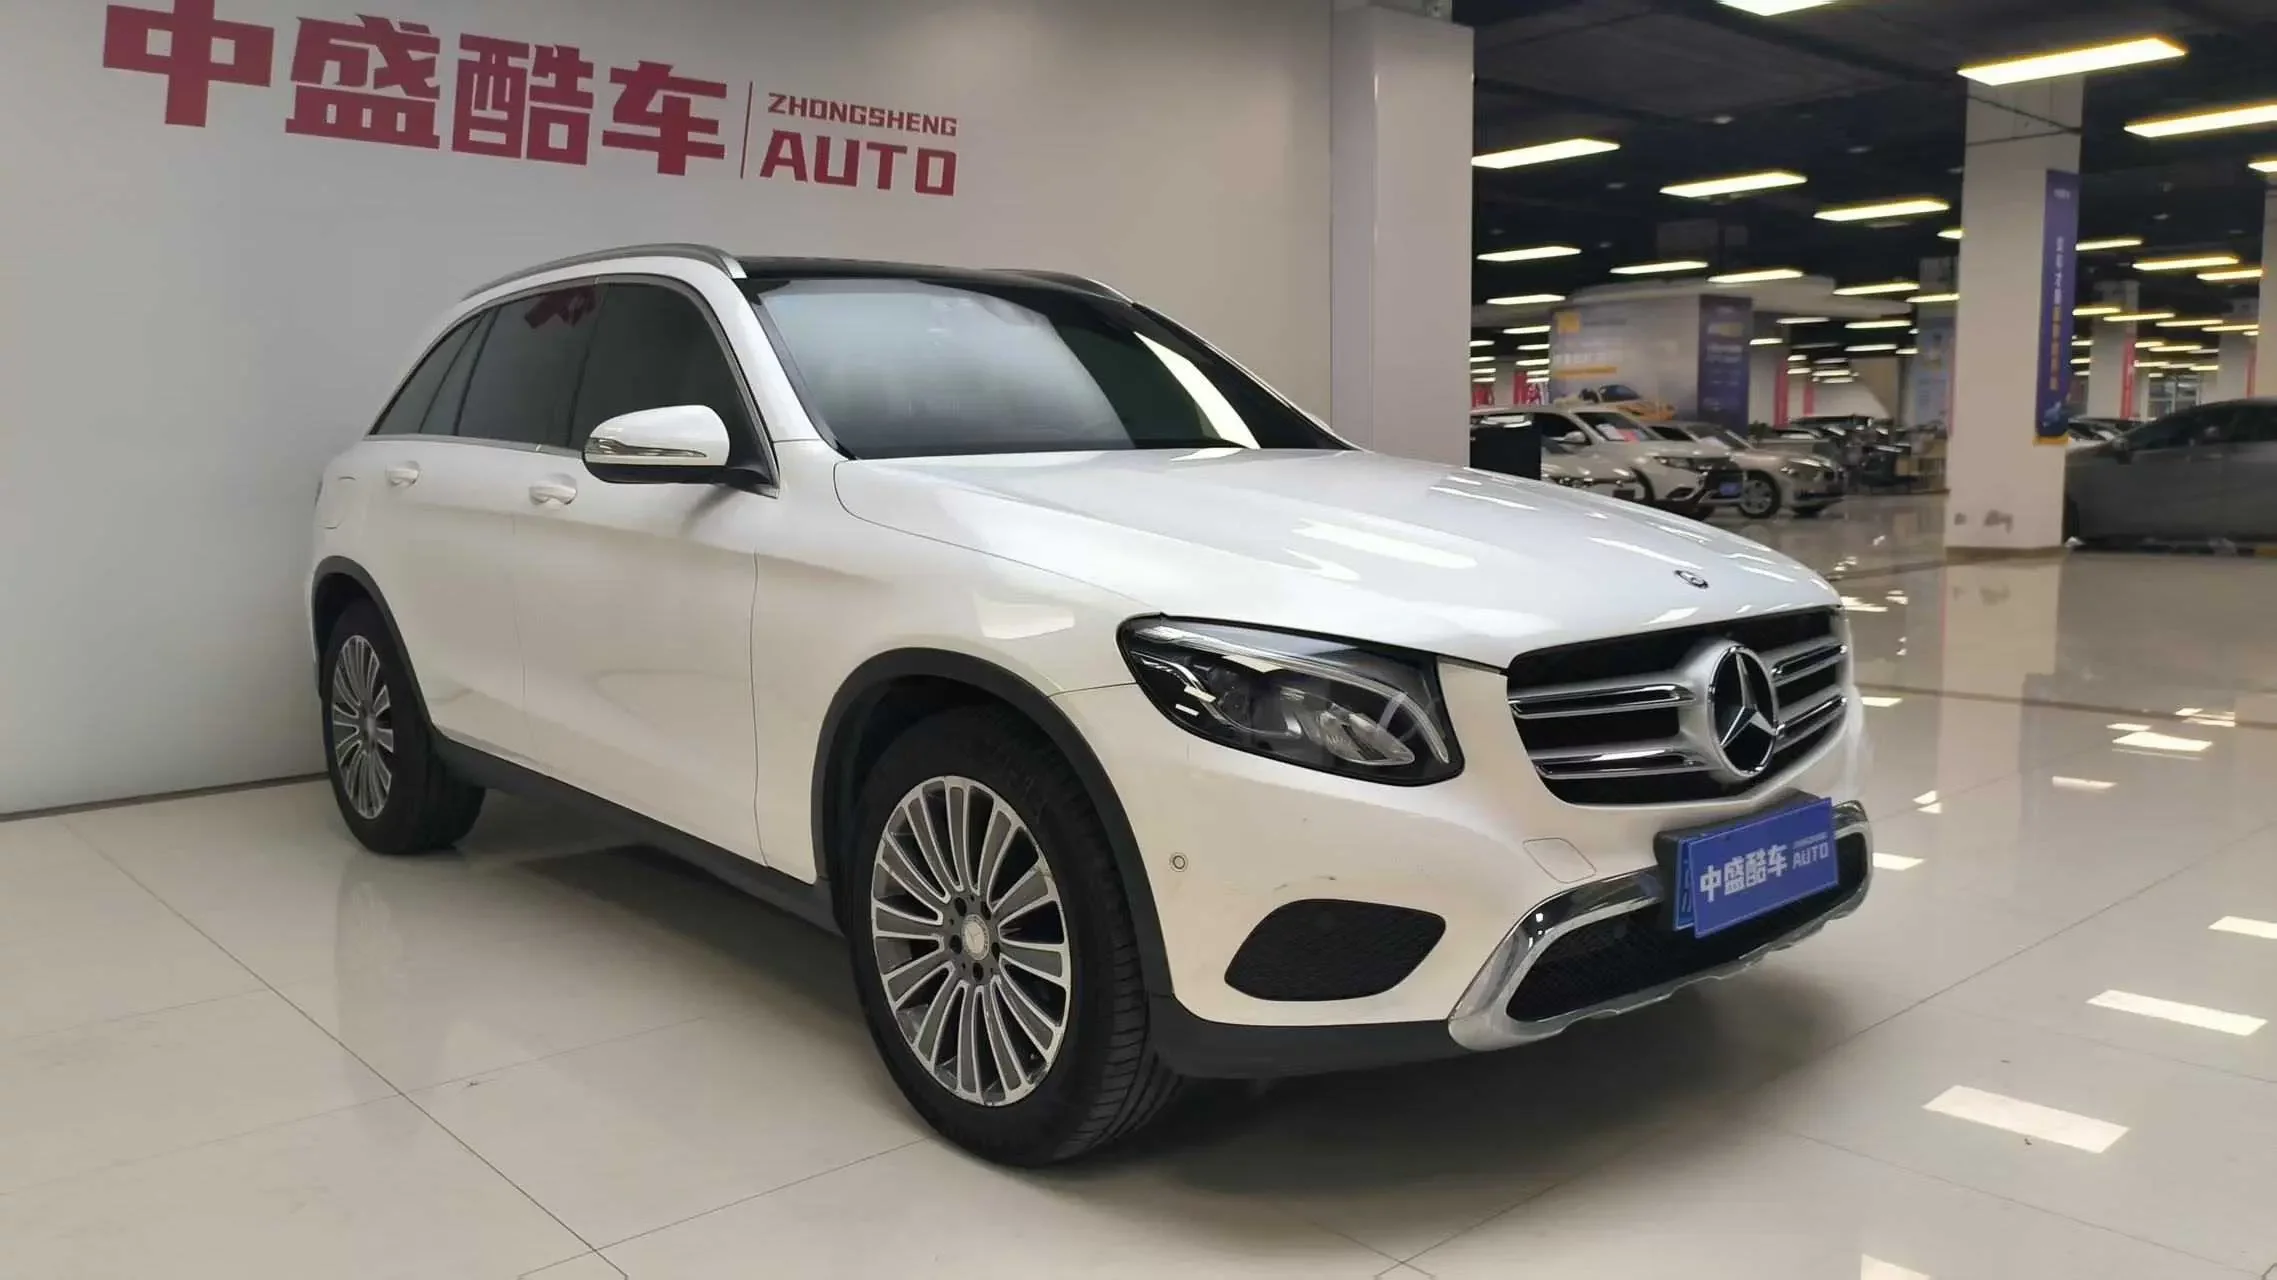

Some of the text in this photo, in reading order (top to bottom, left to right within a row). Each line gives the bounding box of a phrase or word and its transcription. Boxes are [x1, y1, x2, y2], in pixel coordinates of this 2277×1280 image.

[103, 0, 727, 176] 中盛酷车
[767, 92, 957, 137] ZHONGSHENG
[760, 128, 957, 196] AUTO
[1700, 844, 1788, 903] 中盛酷车
[1792, 842, 1829, 869] AUTO
